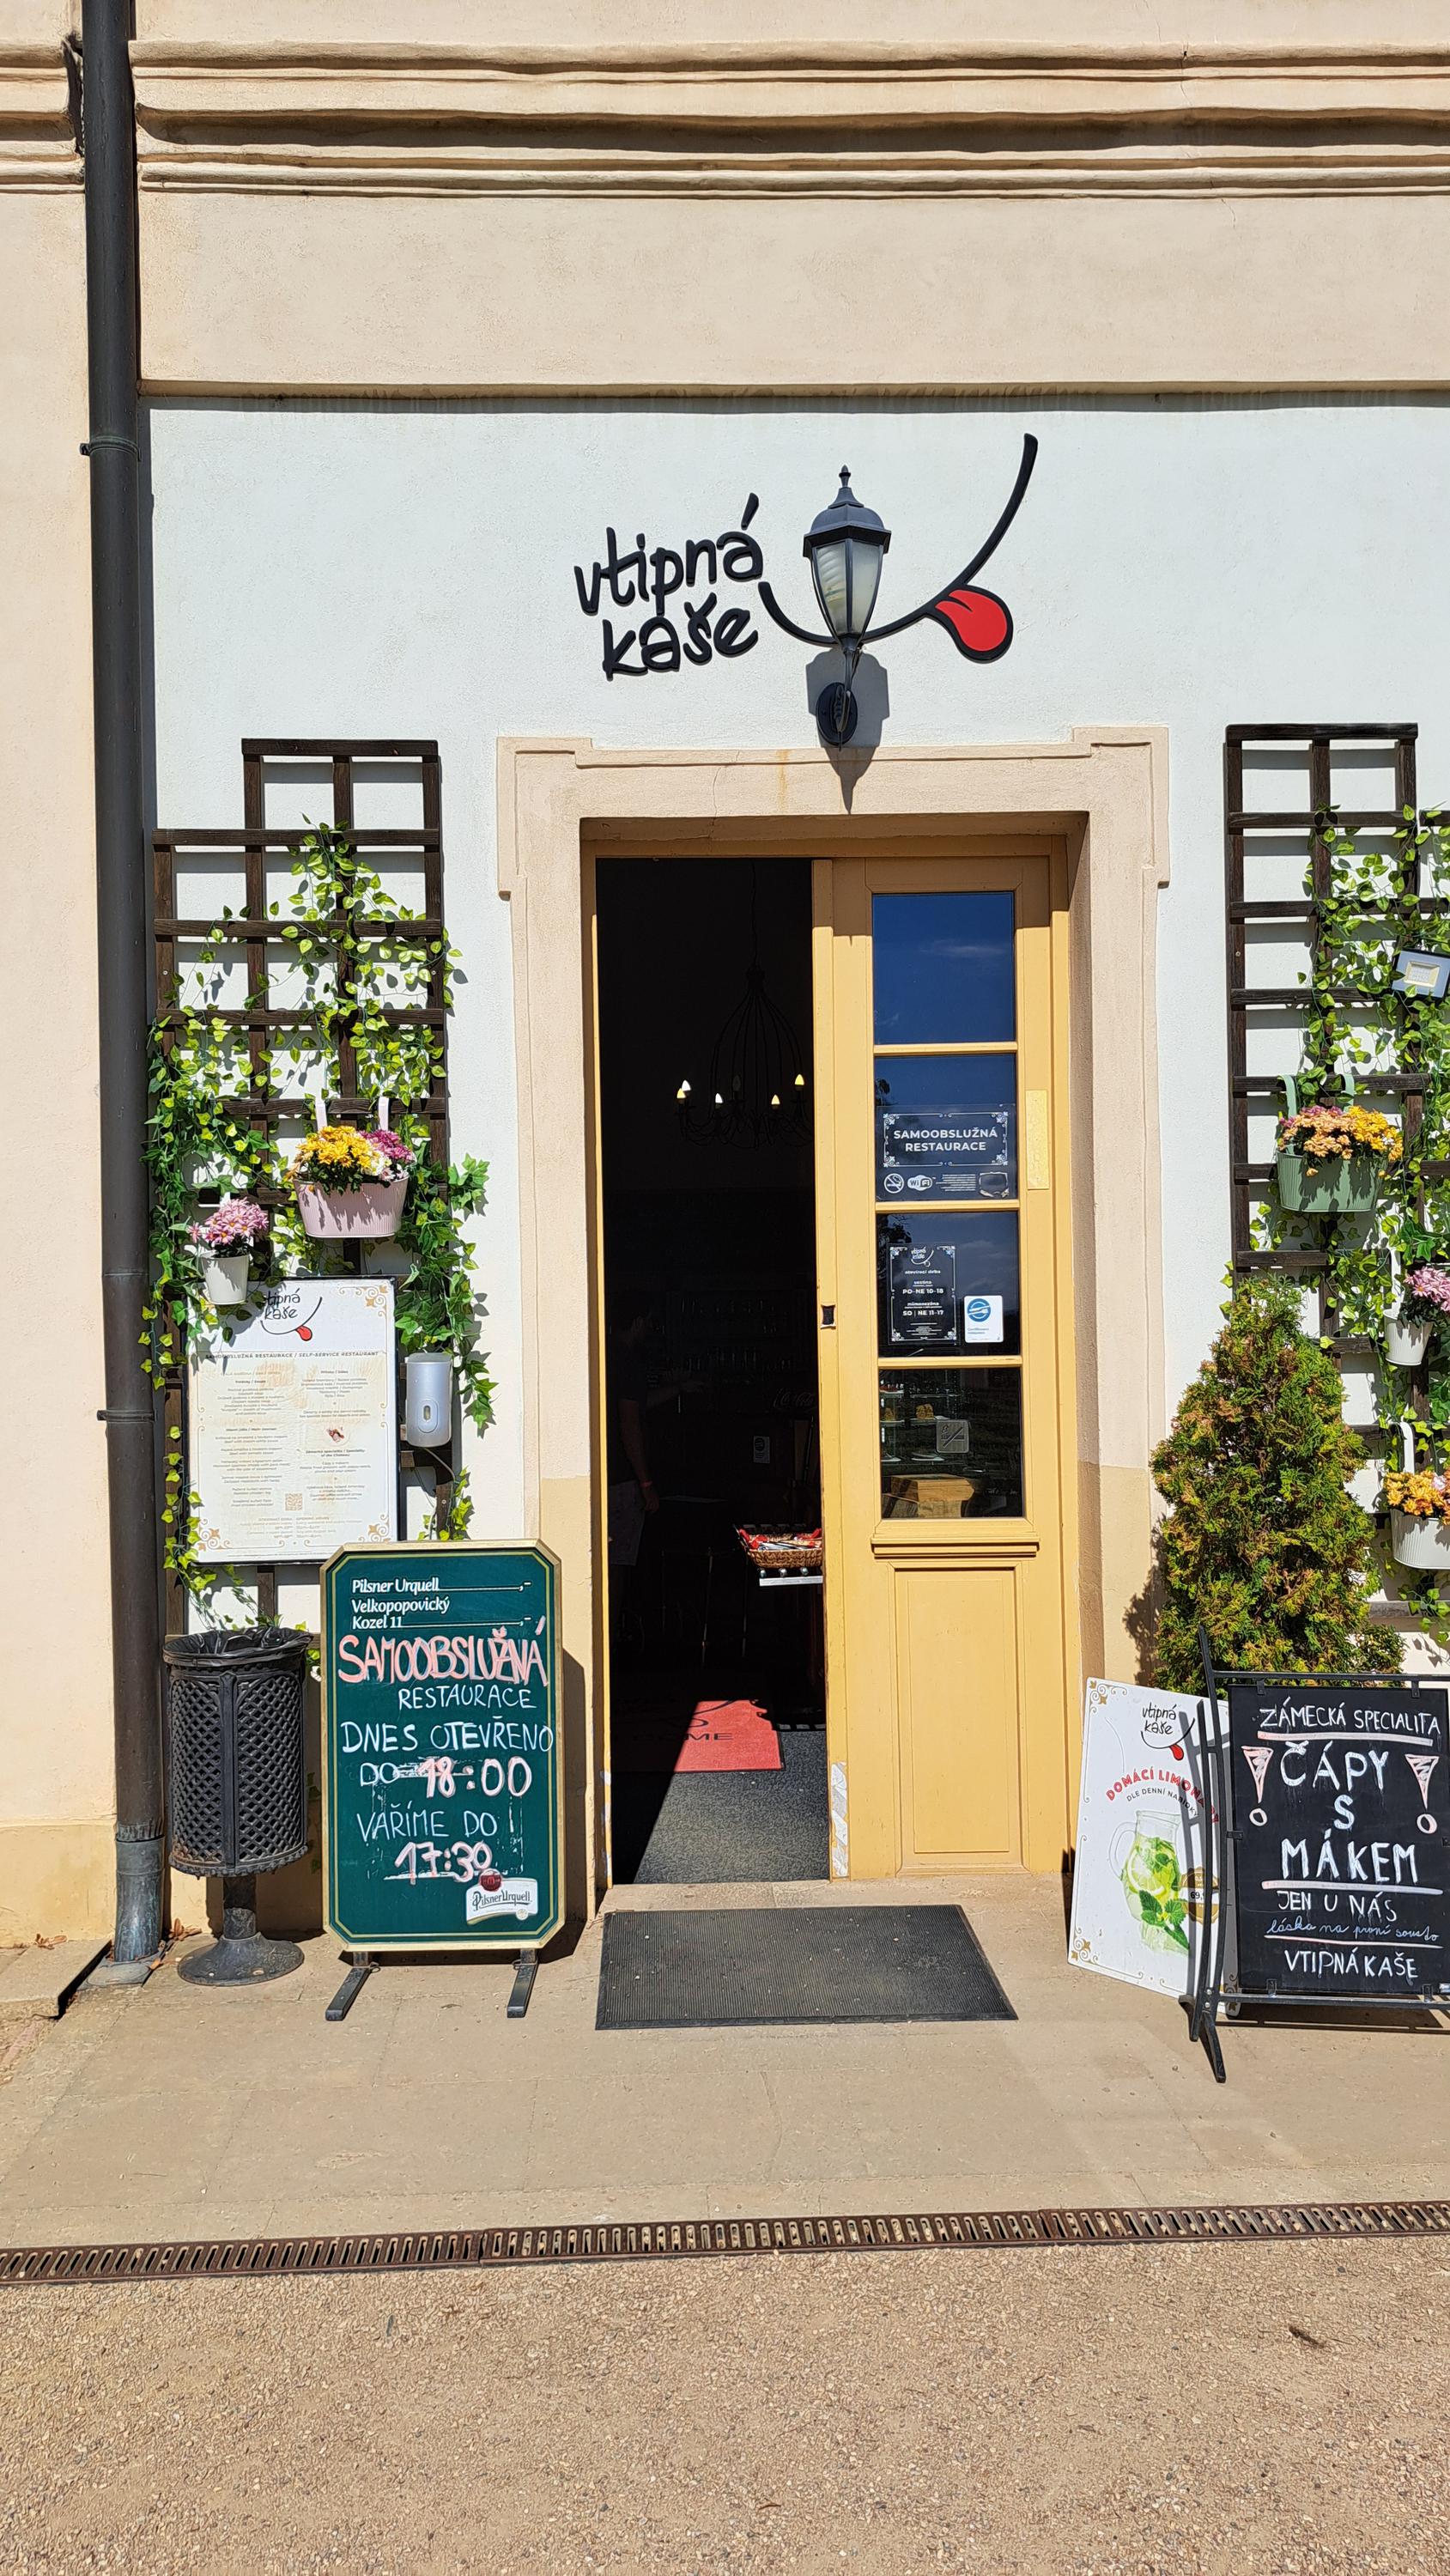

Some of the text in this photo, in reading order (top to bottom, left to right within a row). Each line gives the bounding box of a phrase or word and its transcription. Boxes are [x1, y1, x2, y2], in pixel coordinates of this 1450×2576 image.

[573, 492, 763, 616] vtipná
[603, 592, 758, 680] kaše
[894, 1126, 998, 1139] SAMOOBSLUŽNÁ
[905, 1141, 986, 1151] RESTAURACE
[264, 1305, 298, 1320] kaše
[266, 1287, 301, 1308] tipná
[352, 1578, 394, 1594] Pilsner
[394, 1577, 440, 1595] Urquell
[351, 1596, 451, 1616] Velkopopovický
[352, 1614, 388, 1630] Kozel
[389, 1616, 403, 1629] 11
[337, 1615, 549, 1687] SAMOOBSLUŽNÁ
[398, 1684, 537, 1710] RESTAURACE
[1143, 1701, 1177, 1722] vtipná
[1144, 1720, 1174, 1735] kaše
[1259, 1697, 1441, 1735] ZÁMECKÁ SPECIALITA
[341, 1715, 553, 1753] DNES OTEVŘENO
[360, 1756, 532, 1798] DO 18:00
[1280, 1741, 1389, 1792] ČÁPY
[1106, 1766, 1155, 1801] DOMÁCÍ
[1126, 1790, 1140, 1802] DLE
[1142, 1787, 1166, 1795] DENNÍ
[356, 1801, 497, 1843] VAŘÍME DO
[1333, 1794, 1355, 1831] S
[394, 1841, 493, 1885] 17:30
[1281, 1828, 1417, 1884] MÁKEM
[472, 1889, 531, 1911] Pilsner Urquell
[1277, 1891, 1397, 1922] JEN U NÁS
[1266, 1916, 1317, 1934] láska
[1320, 1924, 1350, 1933] na
[1284, 1947, 1418, 1979] VTIPNÁ KAŠE
